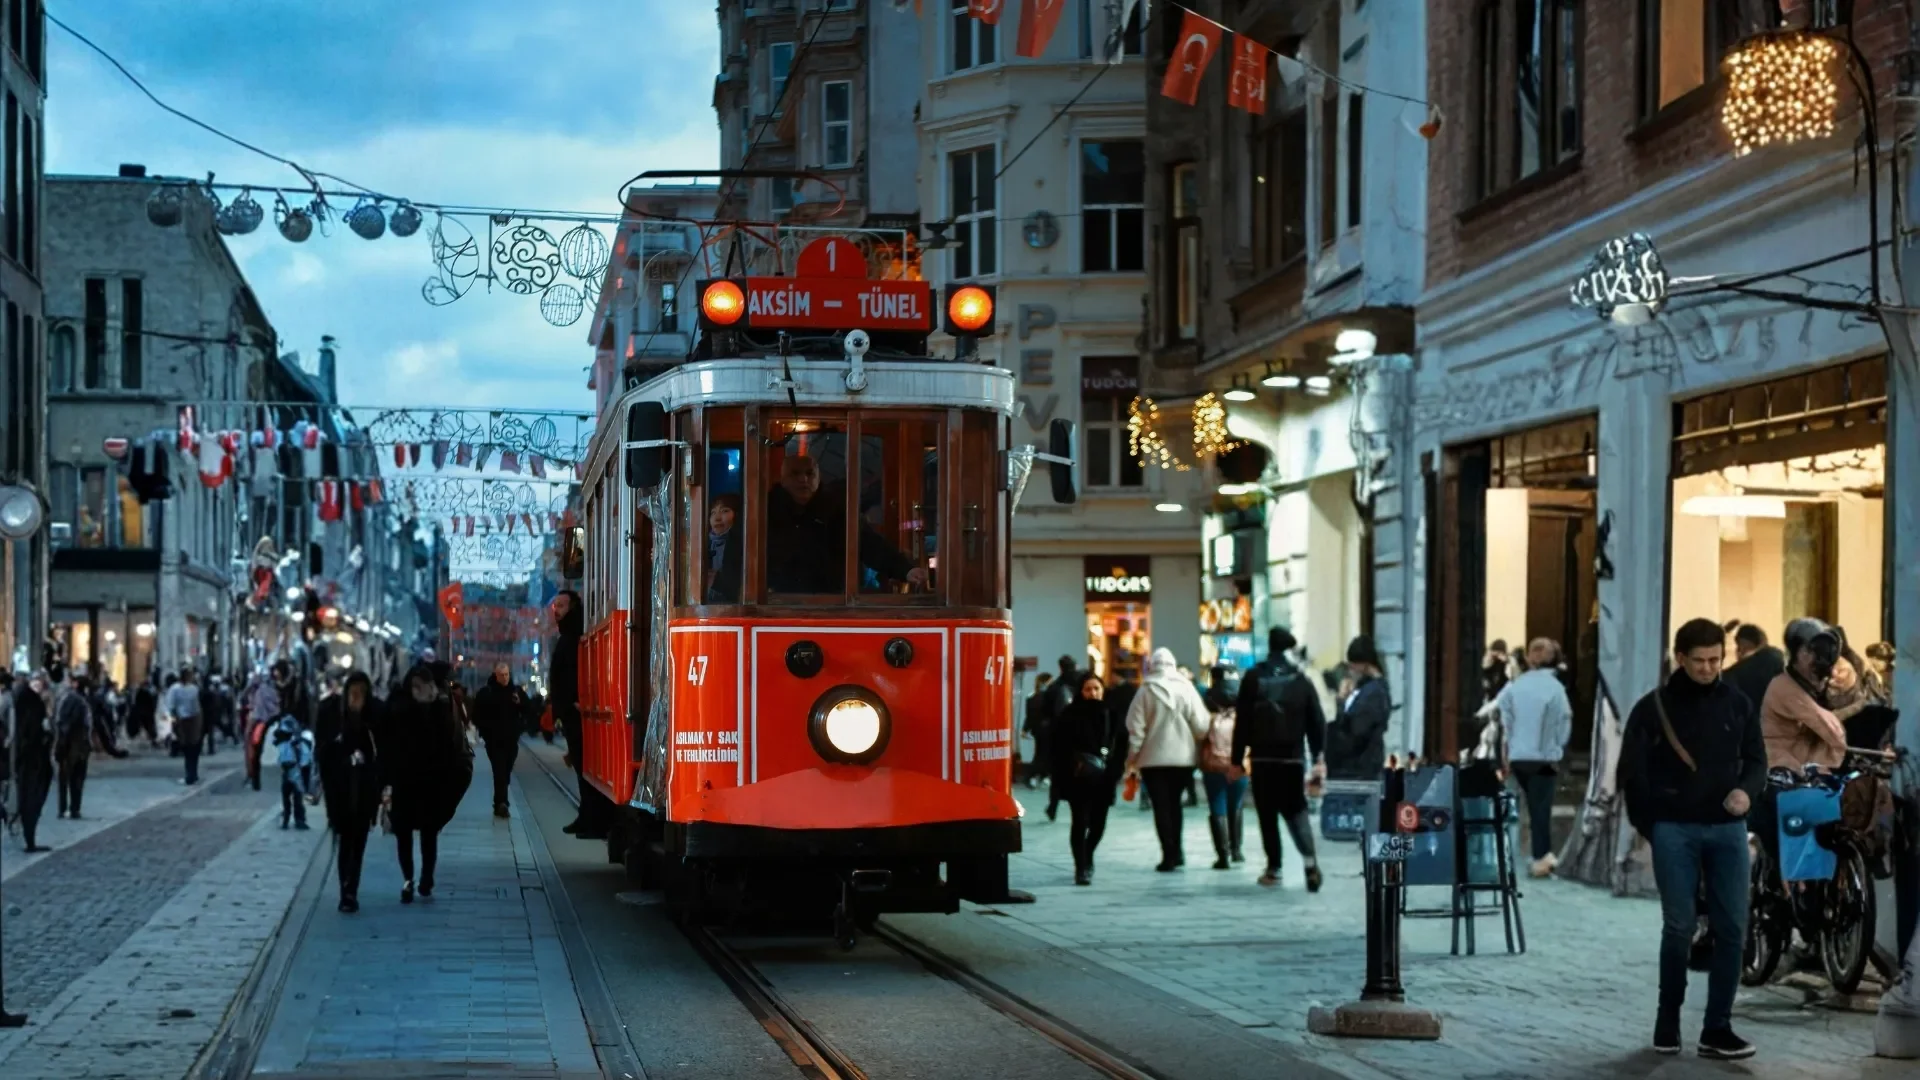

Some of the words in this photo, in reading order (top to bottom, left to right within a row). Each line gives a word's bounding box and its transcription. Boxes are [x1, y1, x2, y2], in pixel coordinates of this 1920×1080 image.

[826, 240, 836, 272] 1
[748, 284, 811, 317] AKSİM
[857, 286, 922, 319] TÜNEL
[1085, 576, 1152, 593] TUDORS
[687, 655, 708, 686] 47
[984, 656, 1005, 686] 47
